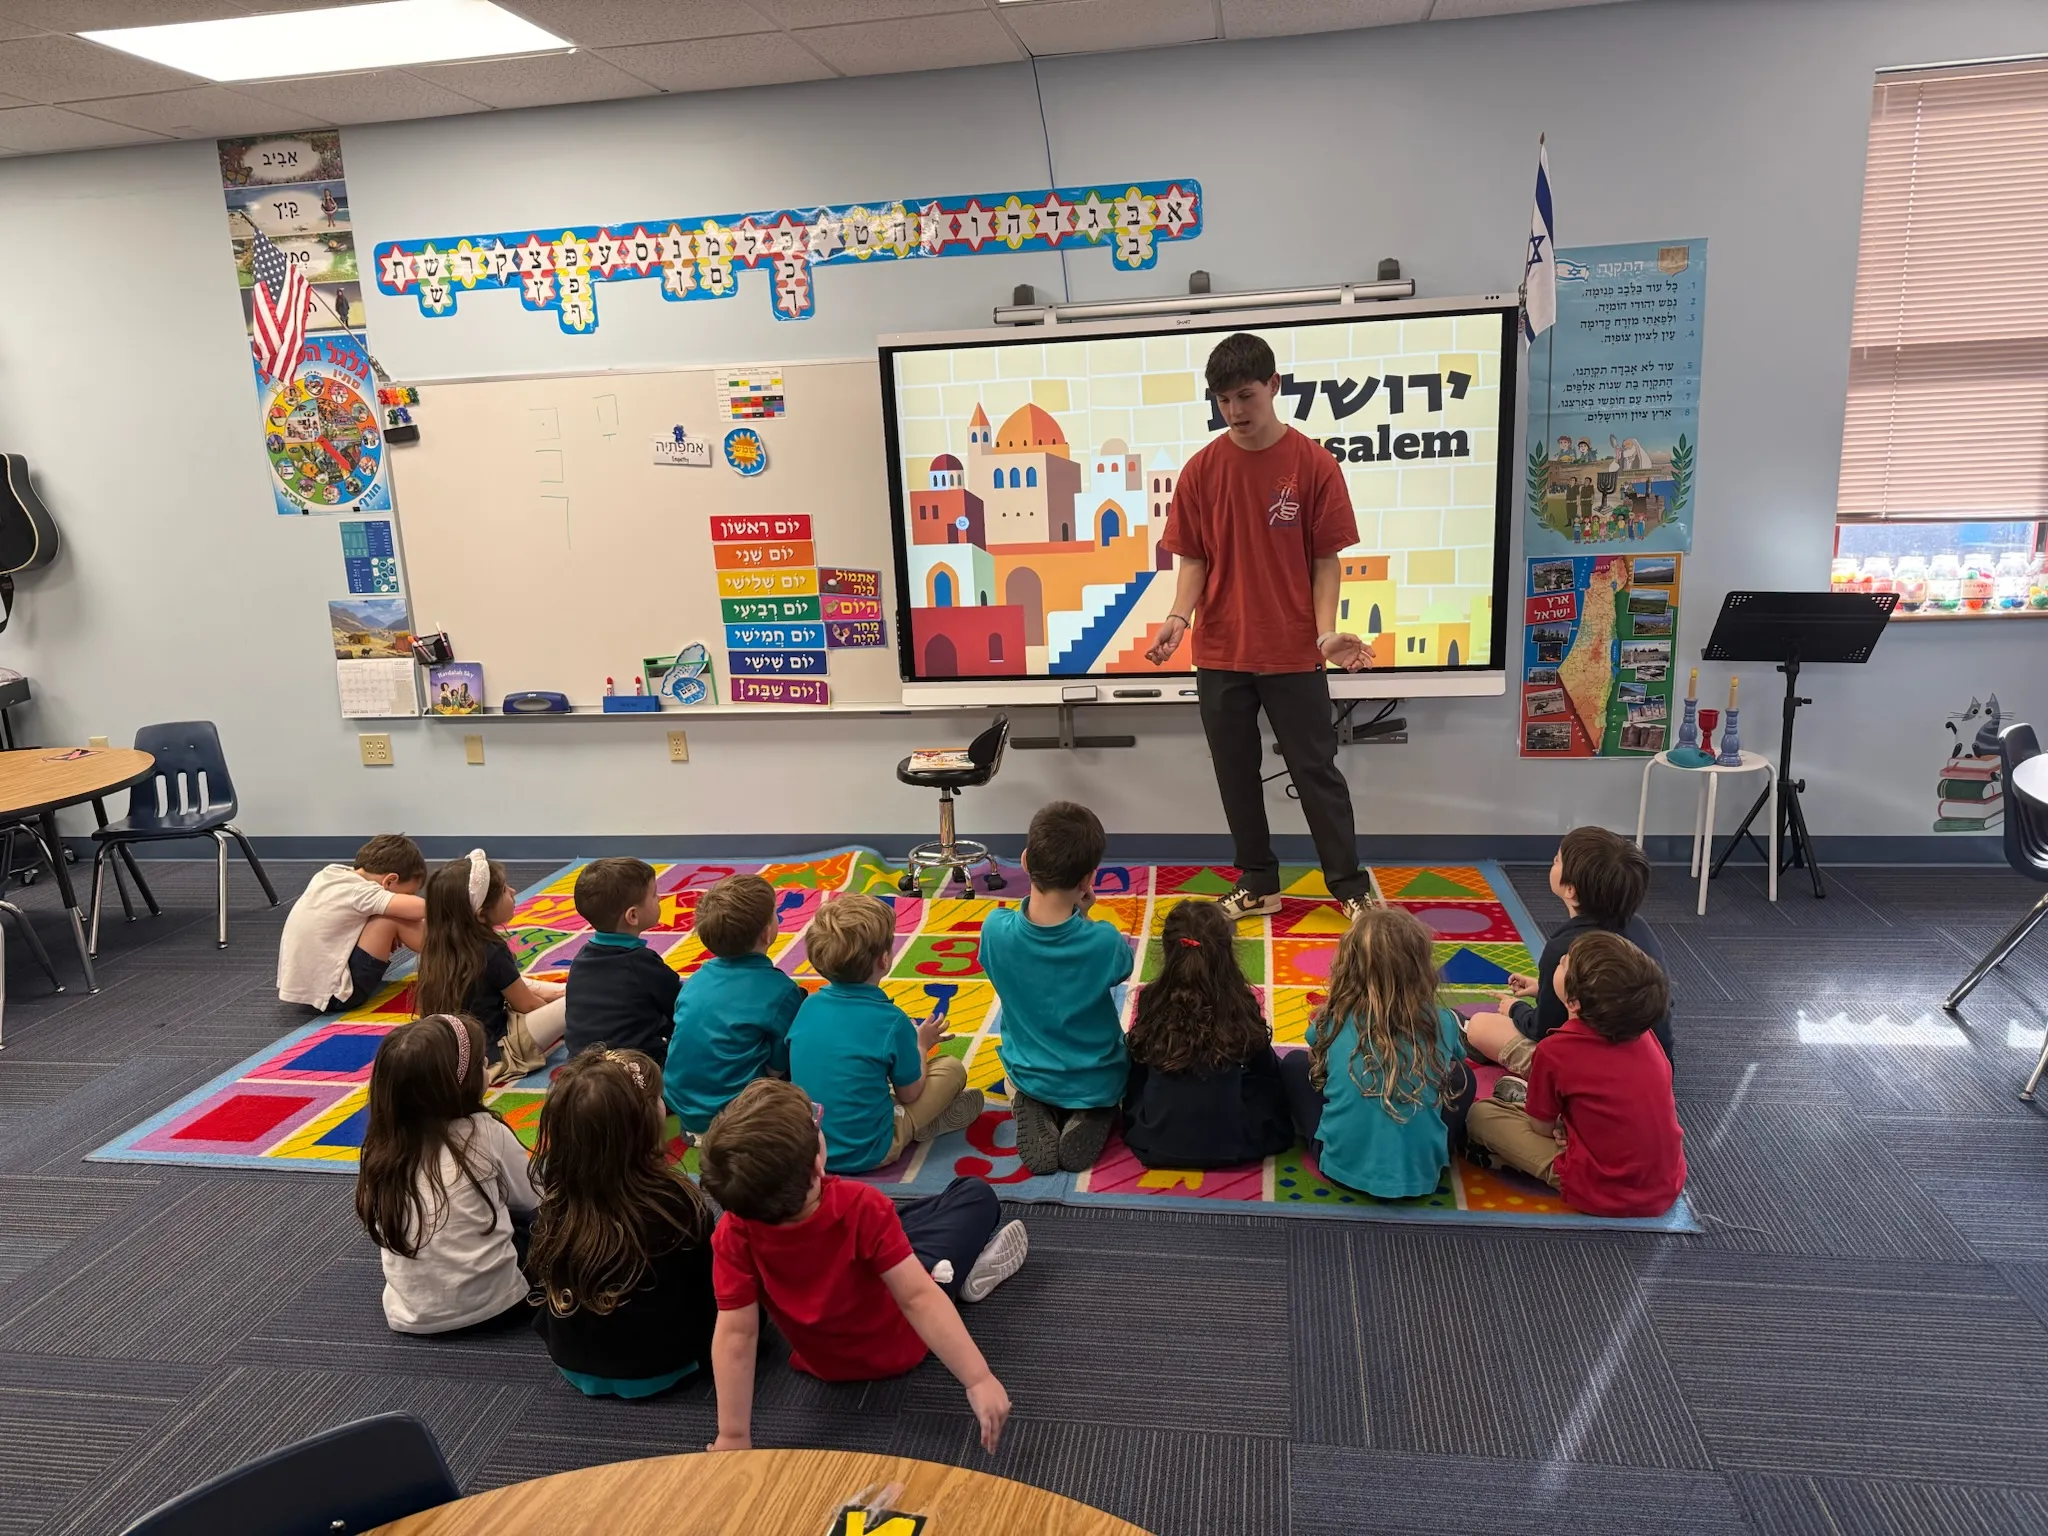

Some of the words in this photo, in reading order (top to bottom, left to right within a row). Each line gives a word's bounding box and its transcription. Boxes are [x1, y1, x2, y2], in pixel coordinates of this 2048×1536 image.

[1046, 210, 1059, 230] ד
[1088, 208, 1099, 228] ג
[1168, 202, 1182, 222] א
[971, 216, 978, 236] ו
[1008, 214, 1020, 234] ה
[635, 243, 648, 260] ס
[673, 240, 681, 258] נ
[706, 237, 720, 256] מ
[743, 229, 756, 254] ל
[1129, 238, 1140, 254] ב
[461, 256, 473, 274] ר
[495, 253, 507, 273] ק
[529, 250, 540, 268] צ
[599, 245, 611, 265] ע
[392, 260, 405, 279] ת
[1206, 370, 1472, 431] ירושל
[1312, 424, 1469, 463] salem
